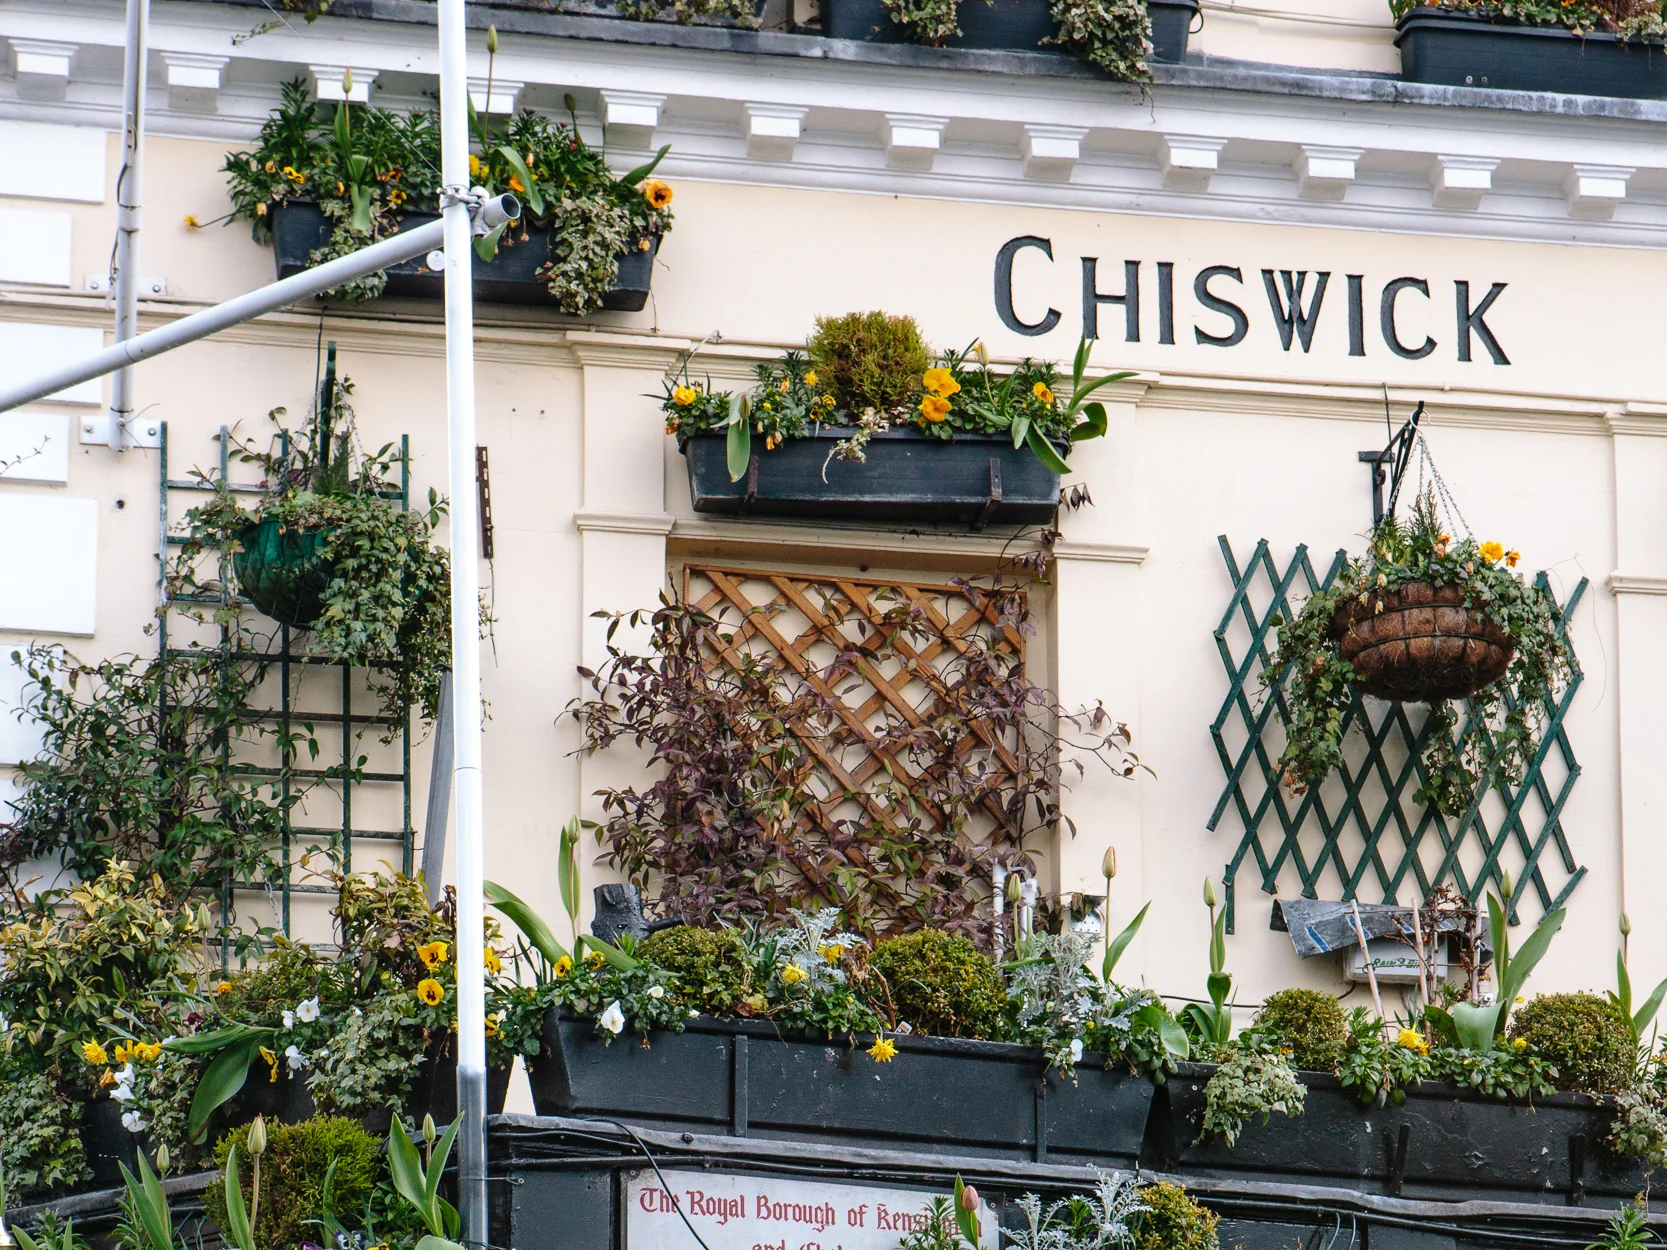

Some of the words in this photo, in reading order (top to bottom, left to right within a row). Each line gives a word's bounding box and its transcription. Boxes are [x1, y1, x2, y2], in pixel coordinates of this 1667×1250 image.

[994, 235, 1511, 365] CHISWICK
[639, 1187, 680, 1213] The
[685, 1190, 745, 1225] Royal
[756, 1195, 836, 1232] Borough
[847, 1202, 874, 1228] of
